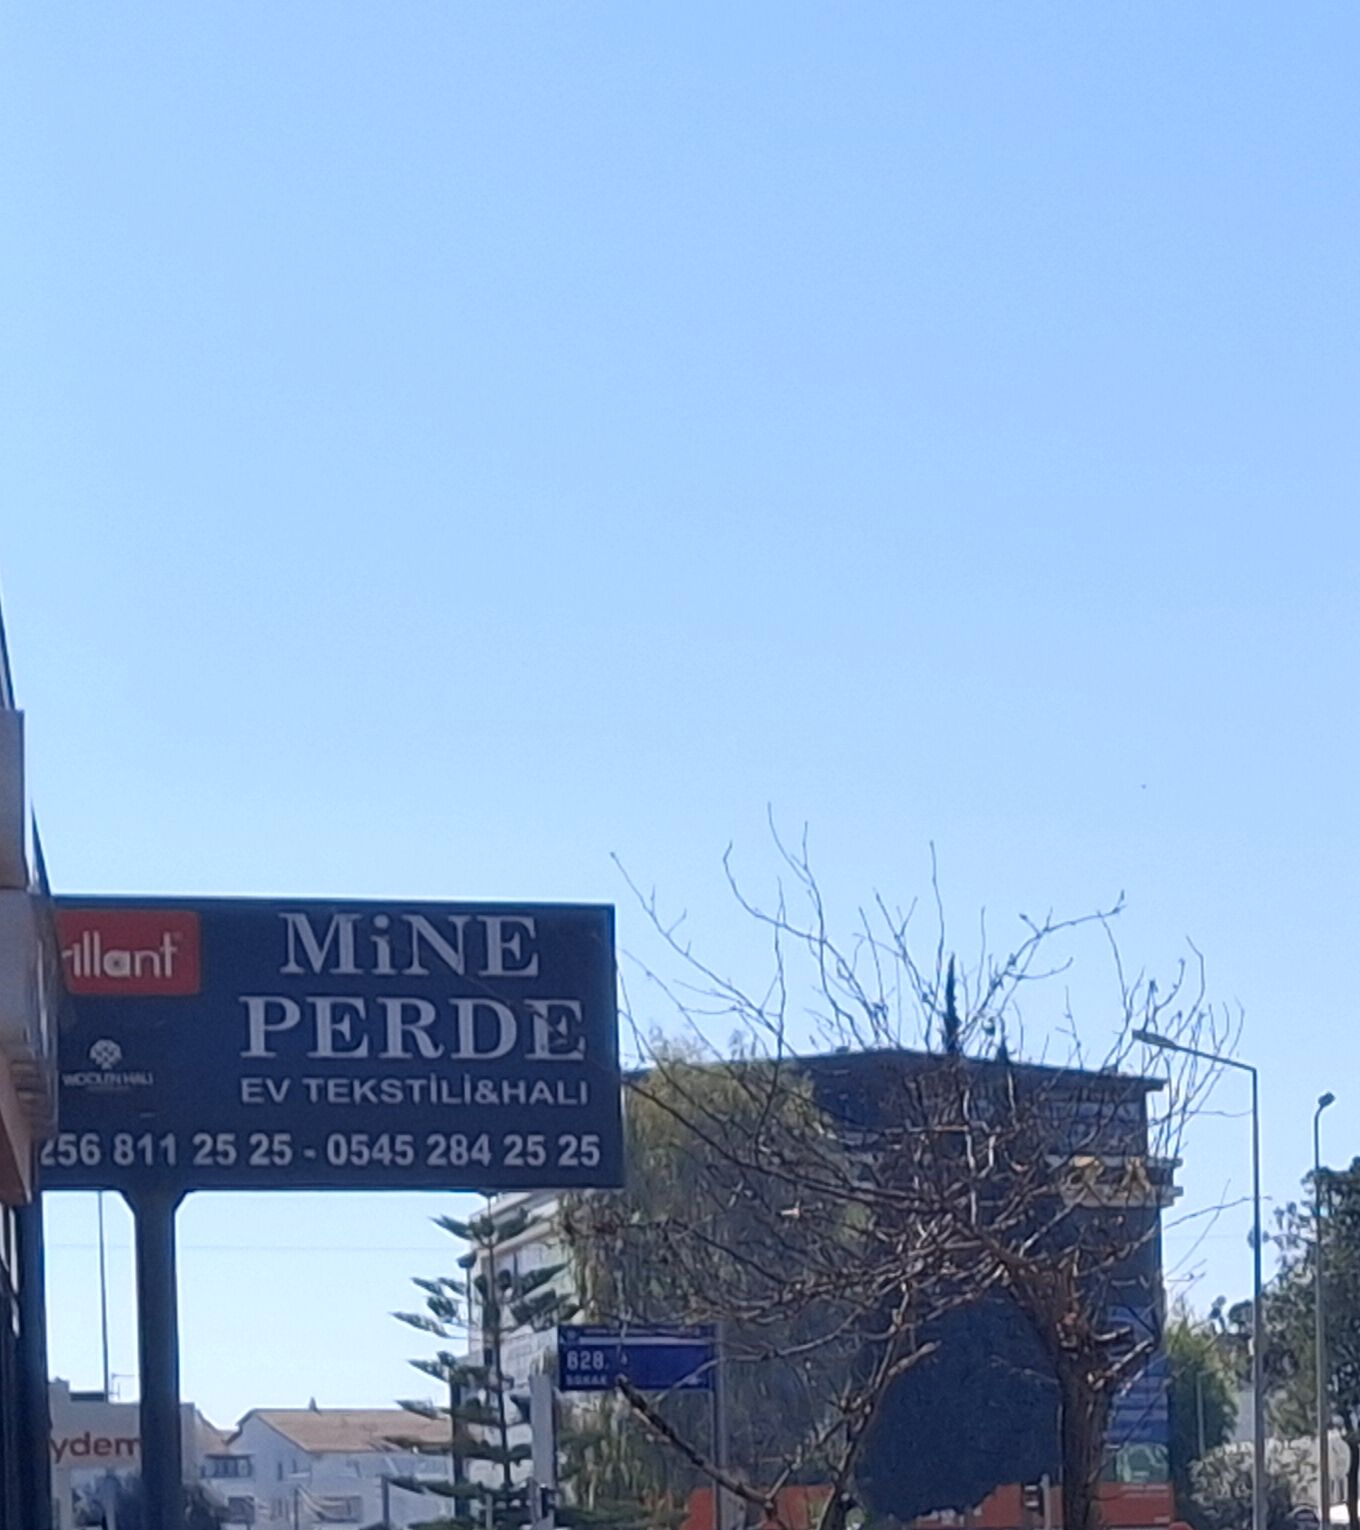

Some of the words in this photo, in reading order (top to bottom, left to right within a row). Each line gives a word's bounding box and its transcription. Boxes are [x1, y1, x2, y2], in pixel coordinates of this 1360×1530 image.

[61, 930, 178, 978] illant
[239, 996, 587, 1061] PERDE
[240, 1078, 292, 1104] EV
[112, 1132, 178, 1167] 811
[191, 1132, 237, 1167] 25
[249, 1133, 293, 1167] 25
[326, 1133, 414, 1168] 0545
[426, 1134, 491, 1168] 284
[503, 1134, 547, 1168] 25
[557, 1134, 601, 1168] 25
